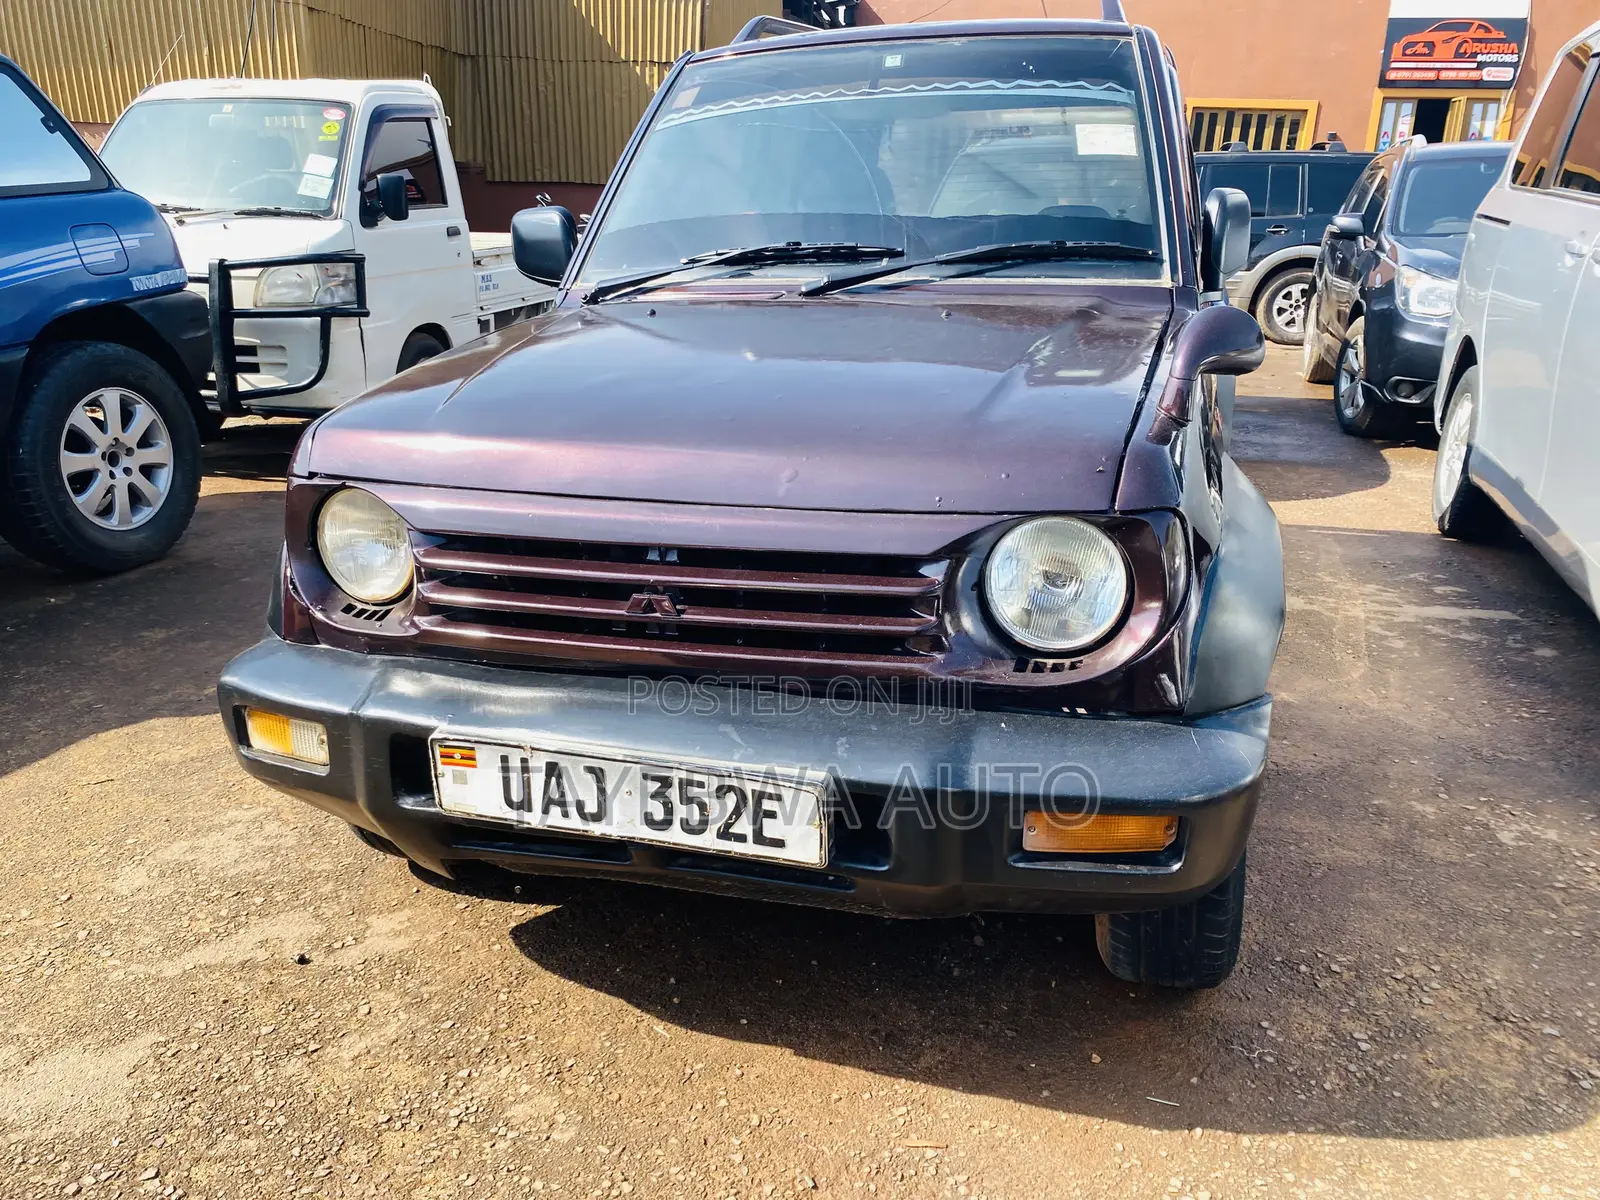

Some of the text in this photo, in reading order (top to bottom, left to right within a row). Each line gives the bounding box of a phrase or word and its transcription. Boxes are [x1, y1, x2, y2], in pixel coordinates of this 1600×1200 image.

[1459, 42, 1518, 54] ARUSHA
[1476, 53, 1518, 63] MOTORS
[499, 754, 786, 849] UAJ 352E
